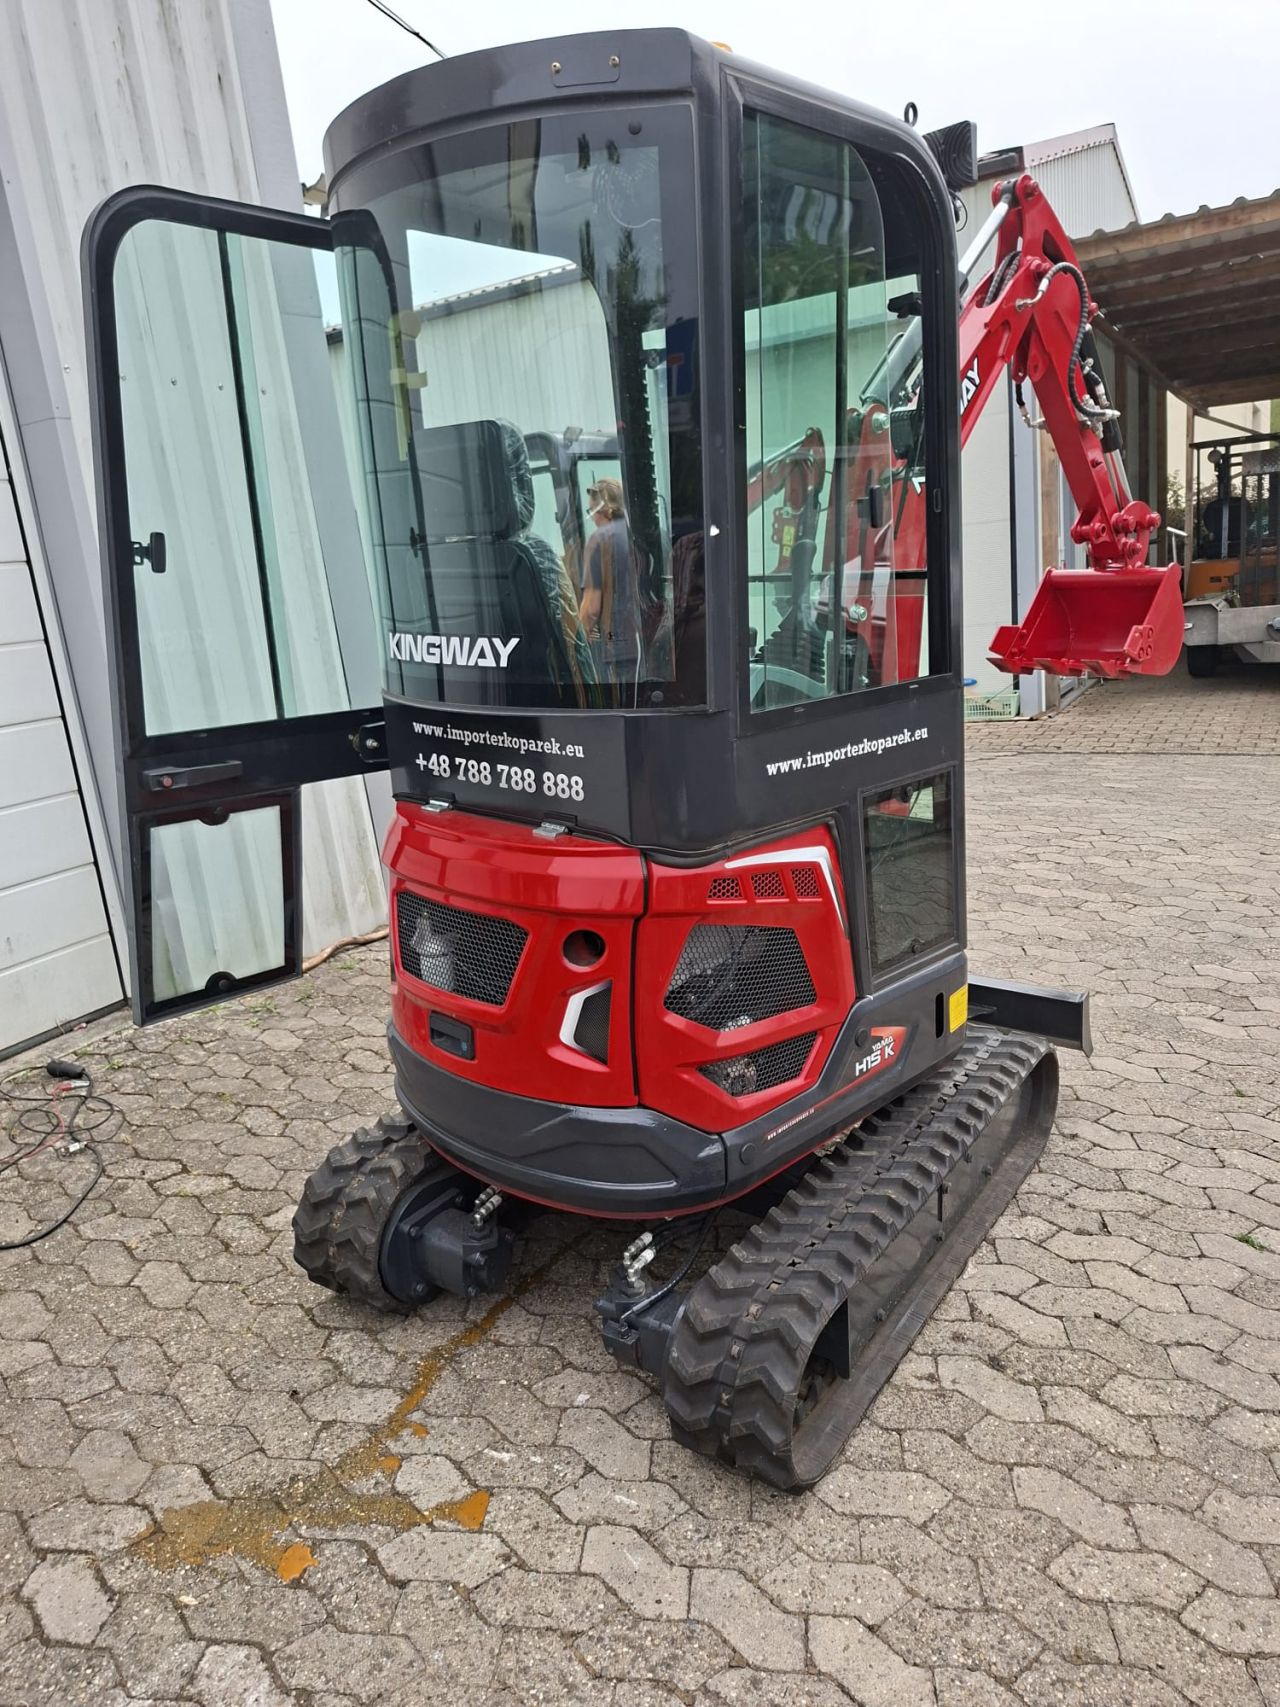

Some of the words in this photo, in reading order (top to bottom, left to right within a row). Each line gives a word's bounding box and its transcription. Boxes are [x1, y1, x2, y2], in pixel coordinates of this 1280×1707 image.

[388, 632, 520, 668] KINGWAY
[412, 721, 585, 758] www.importerkoparek.eu
[766, 727, 929, 776] www.importerkoparek.eu
[415, 752, 451, 778] +48
[455, 757, 492, 786] 788
[497, 764, 537, 793] 788
[543, 771, 585, 802] 888
[884, 1042, 895, 1060] K
